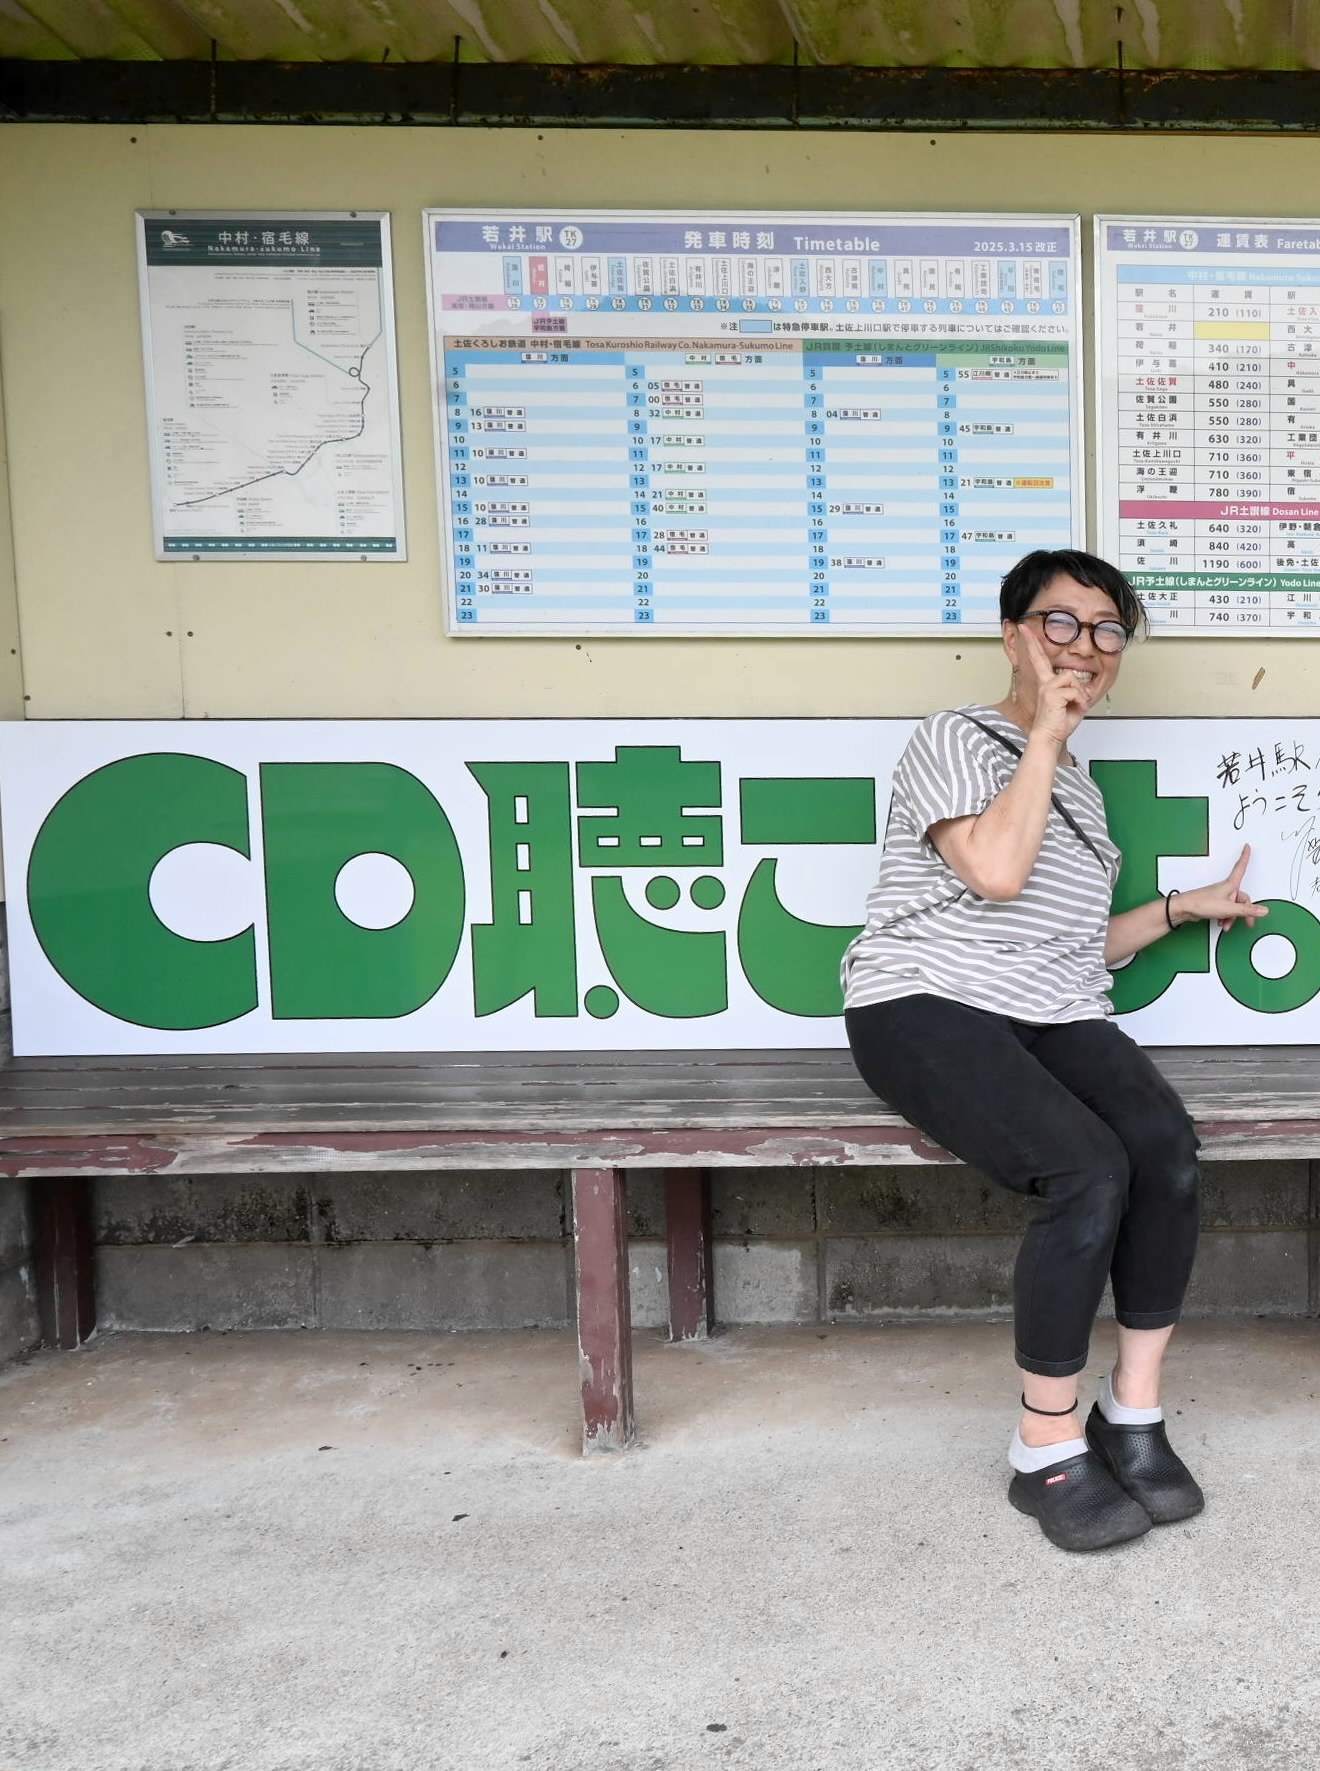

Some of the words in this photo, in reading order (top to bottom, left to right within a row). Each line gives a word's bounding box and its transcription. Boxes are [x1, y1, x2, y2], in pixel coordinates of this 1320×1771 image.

[482, 225, 552, 242] 若井駅
[564, 230, 577, 238] TK
[565, 238, 577, 246] 27
[684, 230, 775, 250] 発車時刻
[794, 237, 880, 251] Timetable
[1123, 229, 1176, 243] 若井駅
[1217, 233, 1269, 248] 運賃表
[453, 340, 526, 349] 土佐くろしお鉄道
[1209, 381, 1229, 389] 480
[1209, 399, 1229, 407] 550
[945, 425, 950, 433] 9
[959, 425, 970, 433] 45
[1133, 450, 1181, 458] 土佐上川口
[1209, 453, 1229, 462] 710
[812, 505, 823, 513] 15
[829, 505, 840, 513] 29
[1272, 508, 1299, 516] Dosan
[1209, 524, 1229, 533] 640
